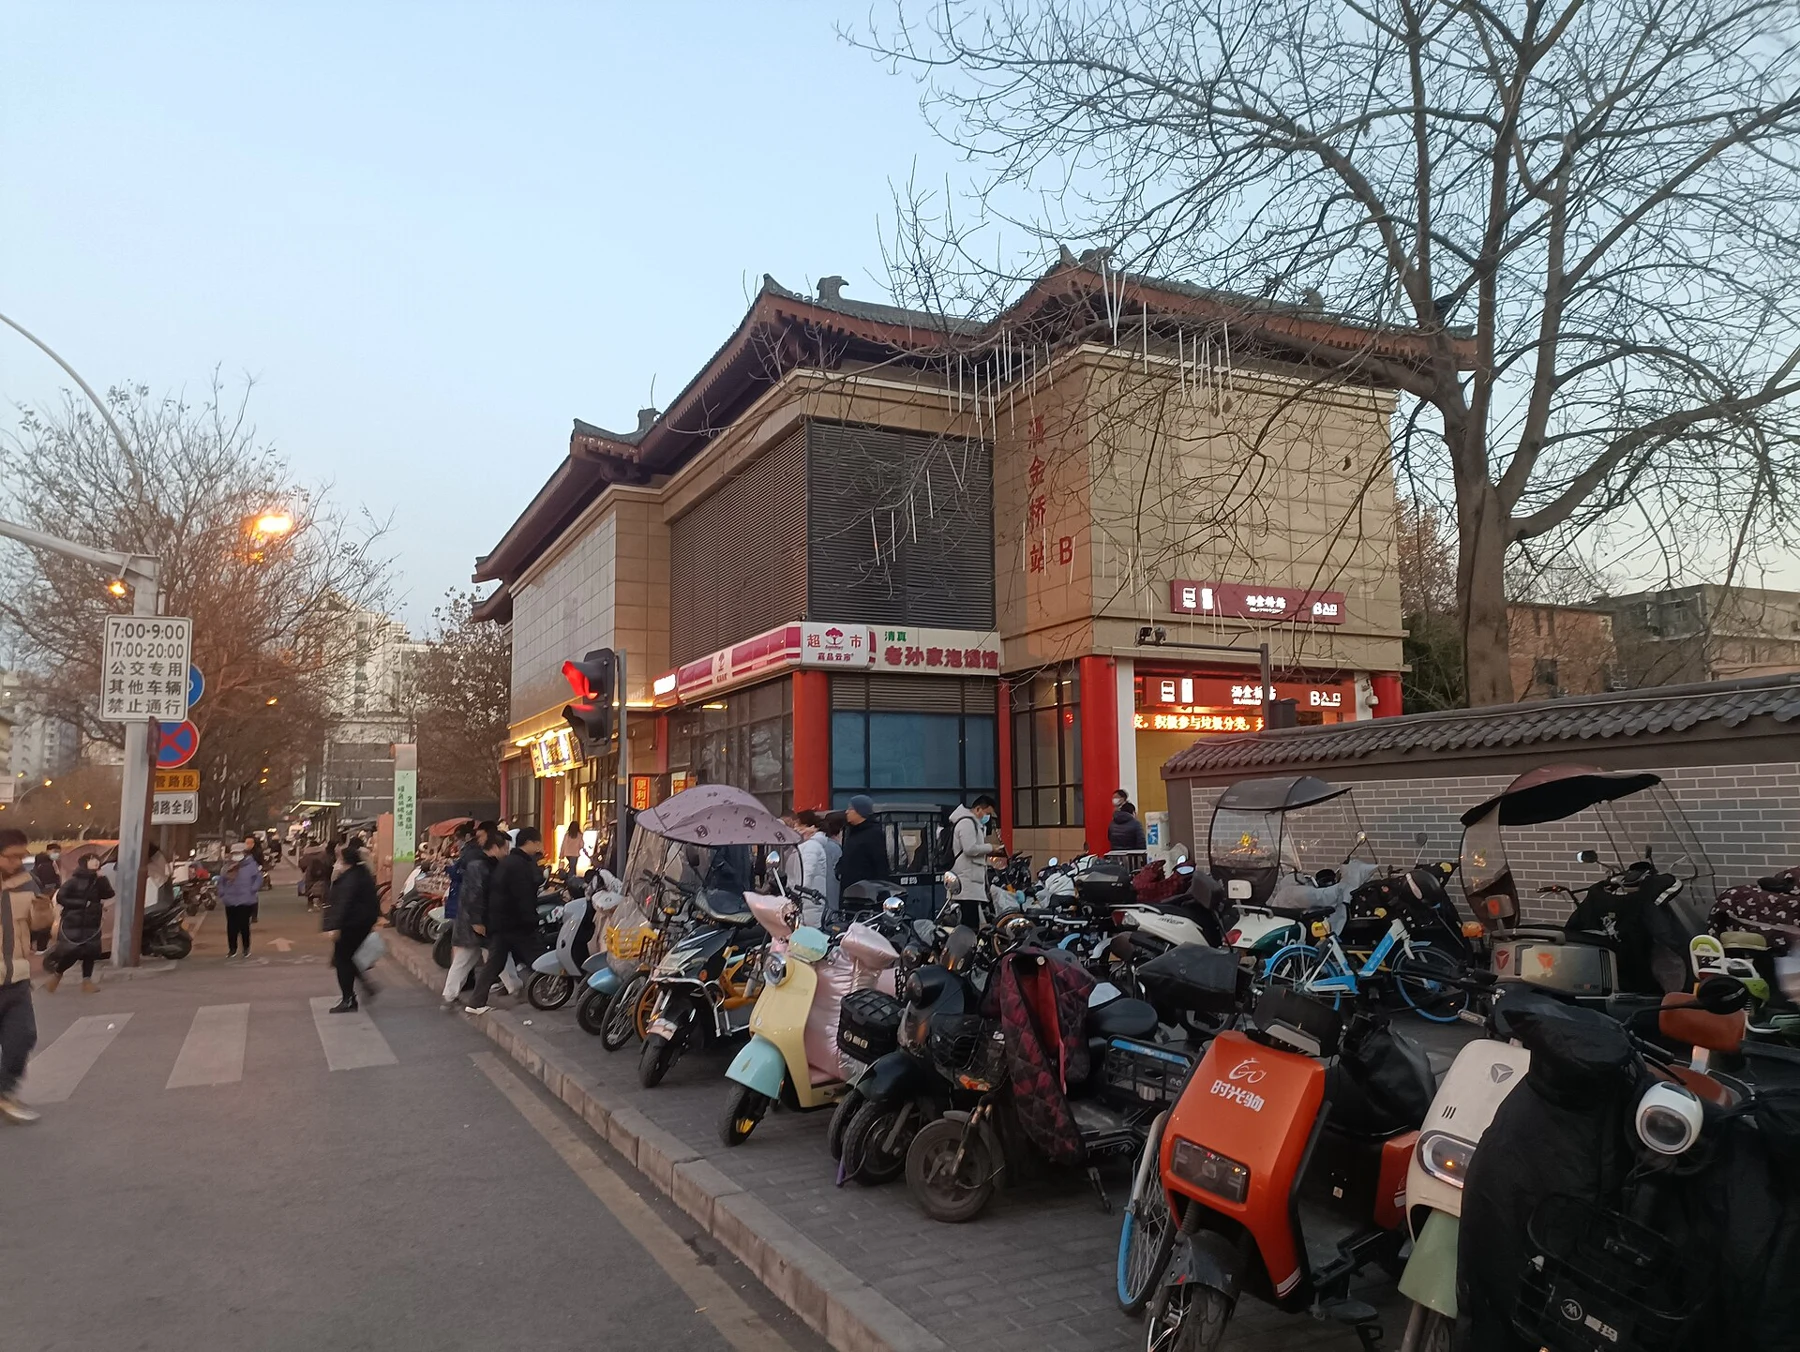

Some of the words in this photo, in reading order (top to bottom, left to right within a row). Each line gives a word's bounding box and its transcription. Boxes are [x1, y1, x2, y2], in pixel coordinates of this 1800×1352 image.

[1059, 536, 1073, 565] B
[111, 622, 185, 640] 7:00-9:00
[884, 631, 907, 642] 清真
[110, 641, 184, 659] 17:00-20:00
[110, 661, 182, 677] 公交专用
[108, 679, 182, 696] 其他车辆
[107, 698, 181, 716] 禁止通行
